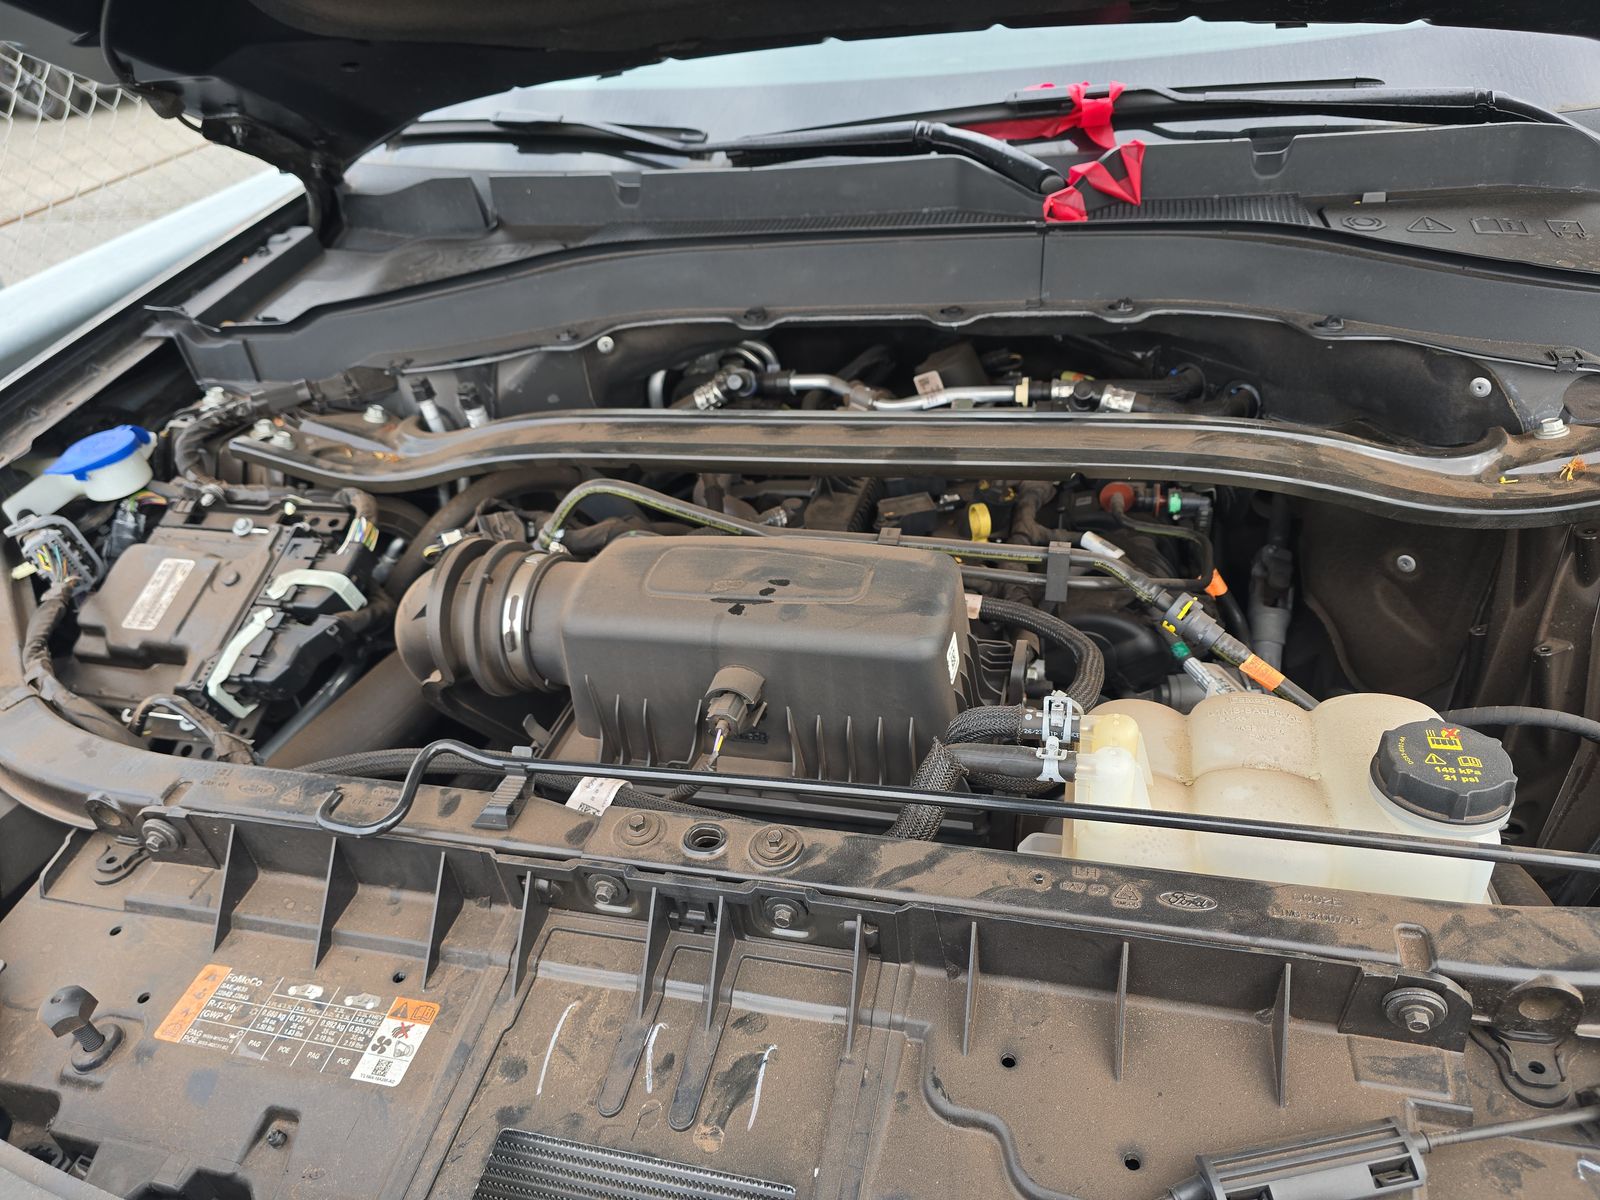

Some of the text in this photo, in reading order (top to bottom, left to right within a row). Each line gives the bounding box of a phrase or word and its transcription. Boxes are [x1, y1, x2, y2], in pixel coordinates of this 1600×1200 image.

[1168, 892, 1209, 908] Ford
[226, 973, 263, 987] FoMoCo
[208, 1000, 243, 1014] R-1234yf
[186, 1028, 203, 1038] PAG
[182, 1035, 199, 1044] POE
[248, 1040, 262, 1048] PAG
[277, 1046, 291, 1054] POE
[307, 1052, 321, 1060] PAG
[337, 1058, 351, 1066] POE
